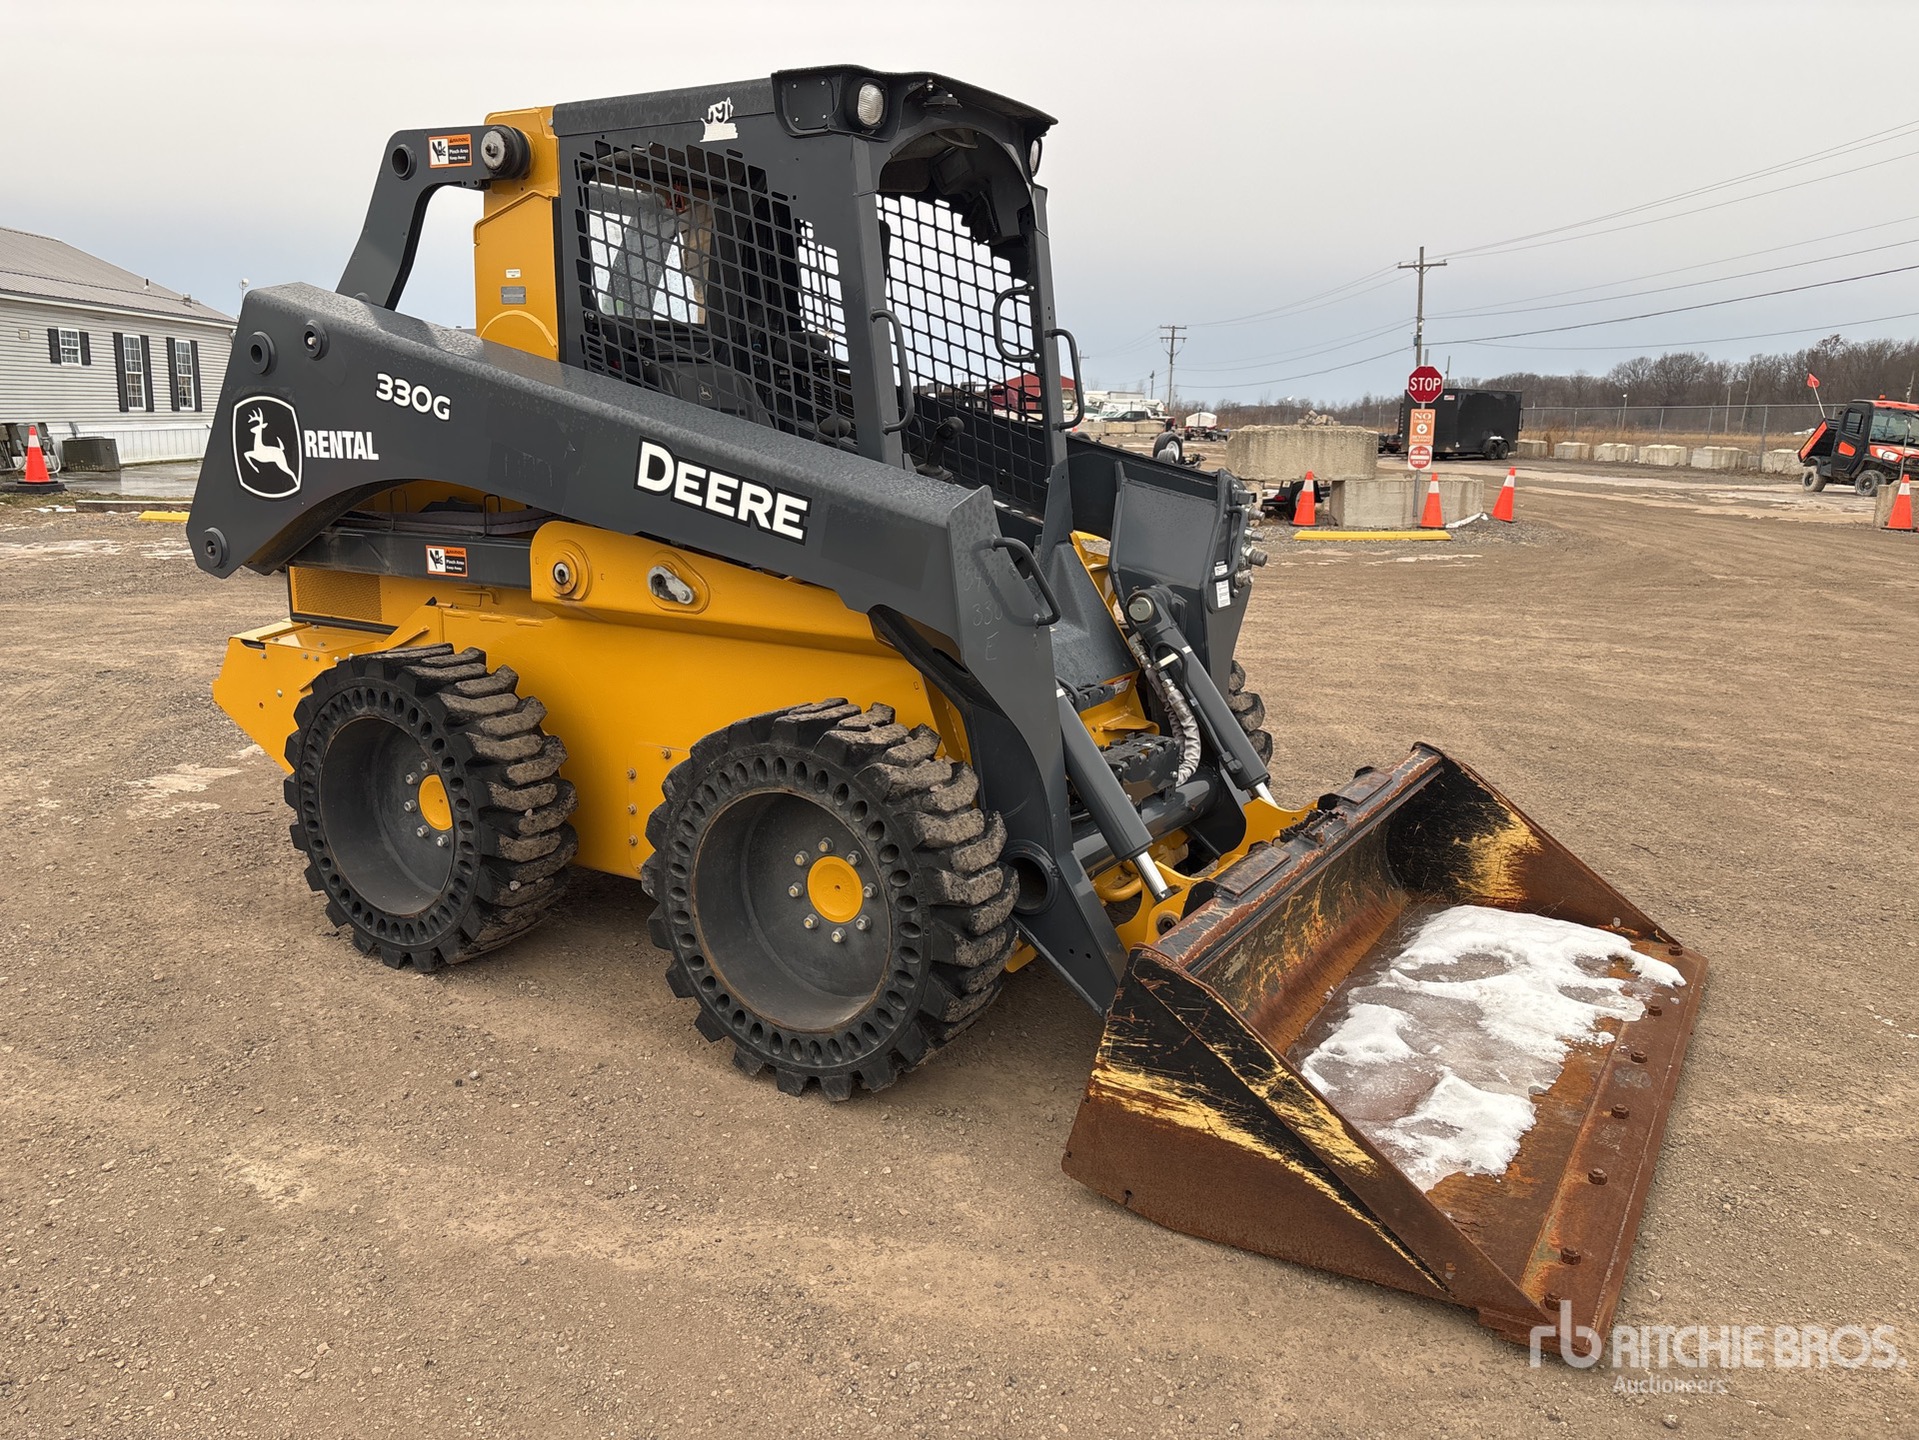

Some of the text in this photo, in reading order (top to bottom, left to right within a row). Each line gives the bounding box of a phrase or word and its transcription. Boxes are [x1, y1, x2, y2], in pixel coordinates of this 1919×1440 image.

[376, 373, 451, 420] 330G
[1410, 377, 1441, 392] STOP
[1414, 412, 1432, 420] NO
[304, 430, 380, 461] RENTAL
[637, 441, 808, 540] DEERE
